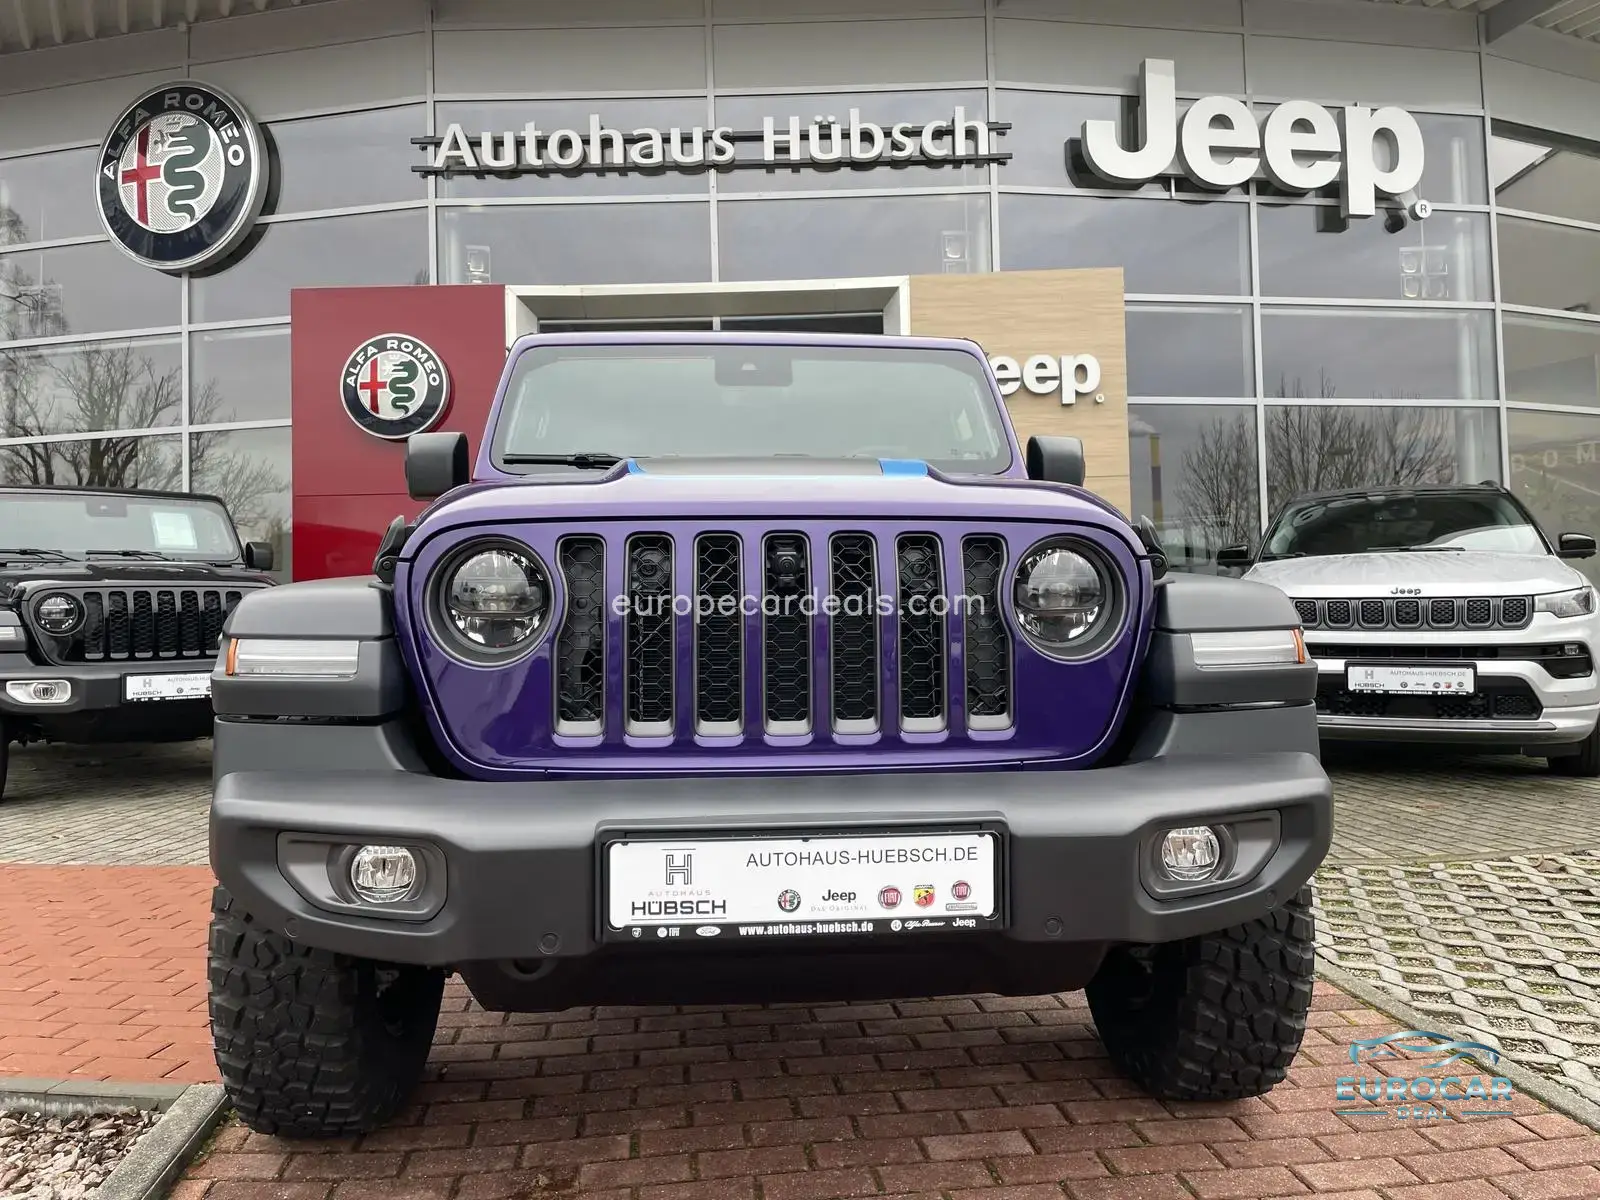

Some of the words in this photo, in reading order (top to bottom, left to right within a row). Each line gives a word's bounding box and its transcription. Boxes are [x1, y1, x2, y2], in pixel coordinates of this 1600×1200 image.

[103, 107, 150, 180] ALFA
[164, 92, 245, 167] ROMEO
[434, 113, 735, 168] Autohaus
[763, 106, 990, 163] Hübsch
[1081, 58, 1424, 218] Jeep
[346, 345, 379, 387] ALFA
[386, 339, 440, 386] ROMEO
[988, 353, 1101, 405] eep
[1390, 587, 1422, 596] Jeep
[746, 846, 979, 868] AUTOHAUS-HUEBSCH.DE
[648, 889, 711, 897] AUTOHAUS
[822, 889, 857, 903] Jeep
[631, 899, 727, 916] HÜBSCH
[739, 921, 874, 936] www.autohaus-huebsch.de
[952, 918, 976, 928] Jeep
